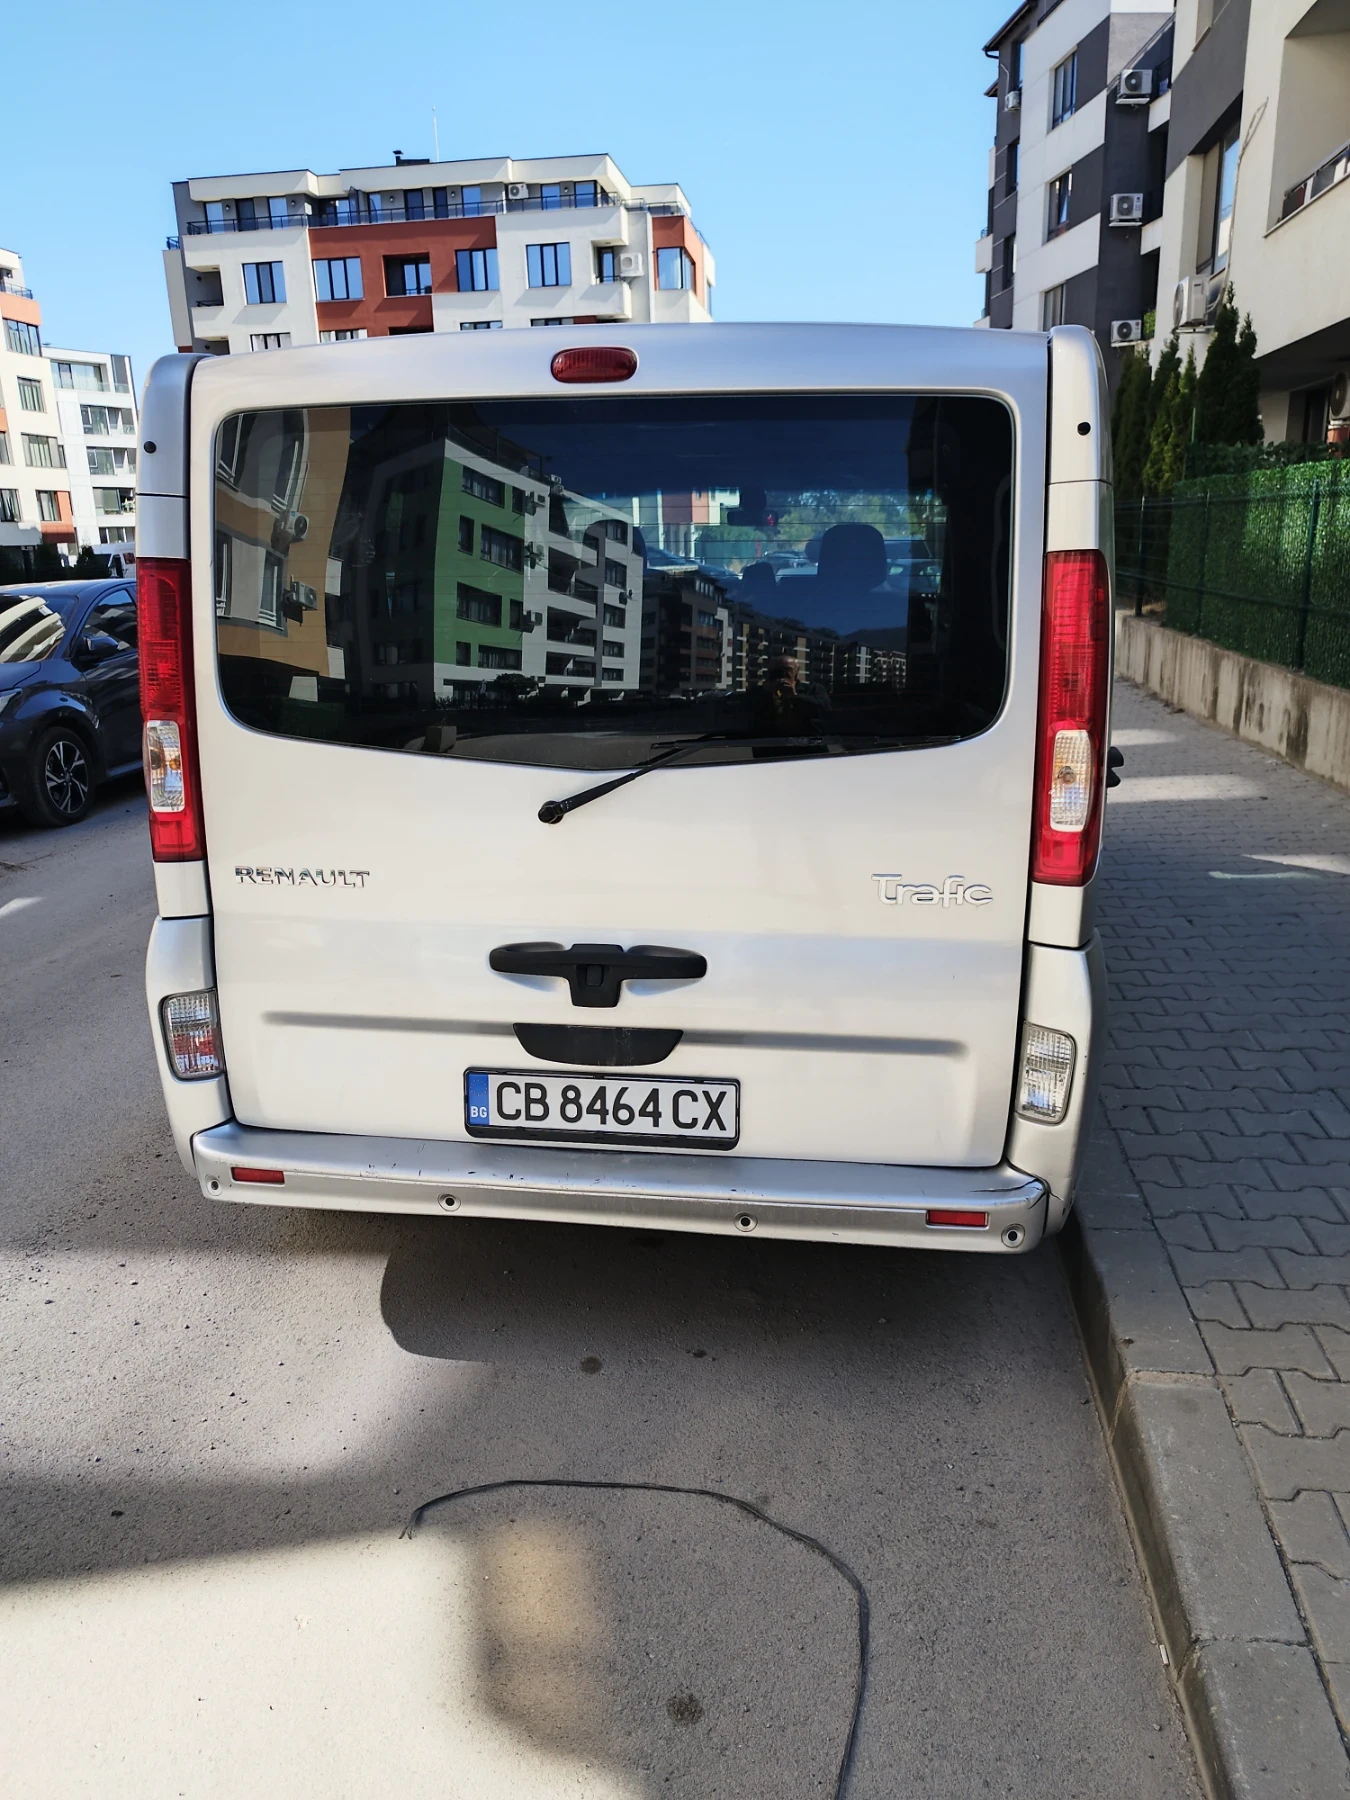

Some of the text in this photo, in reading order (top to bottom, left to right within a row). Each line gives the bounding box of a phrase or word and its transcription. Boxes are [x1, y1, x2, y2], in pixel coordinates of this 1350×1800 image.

[235, 866, 370, 888] RENAULT
[871, 874, 993, 908] Trafic
[471, 1106, 487, 1118] BG
[496, 1082, 727, 1130] CB 8464 CX
